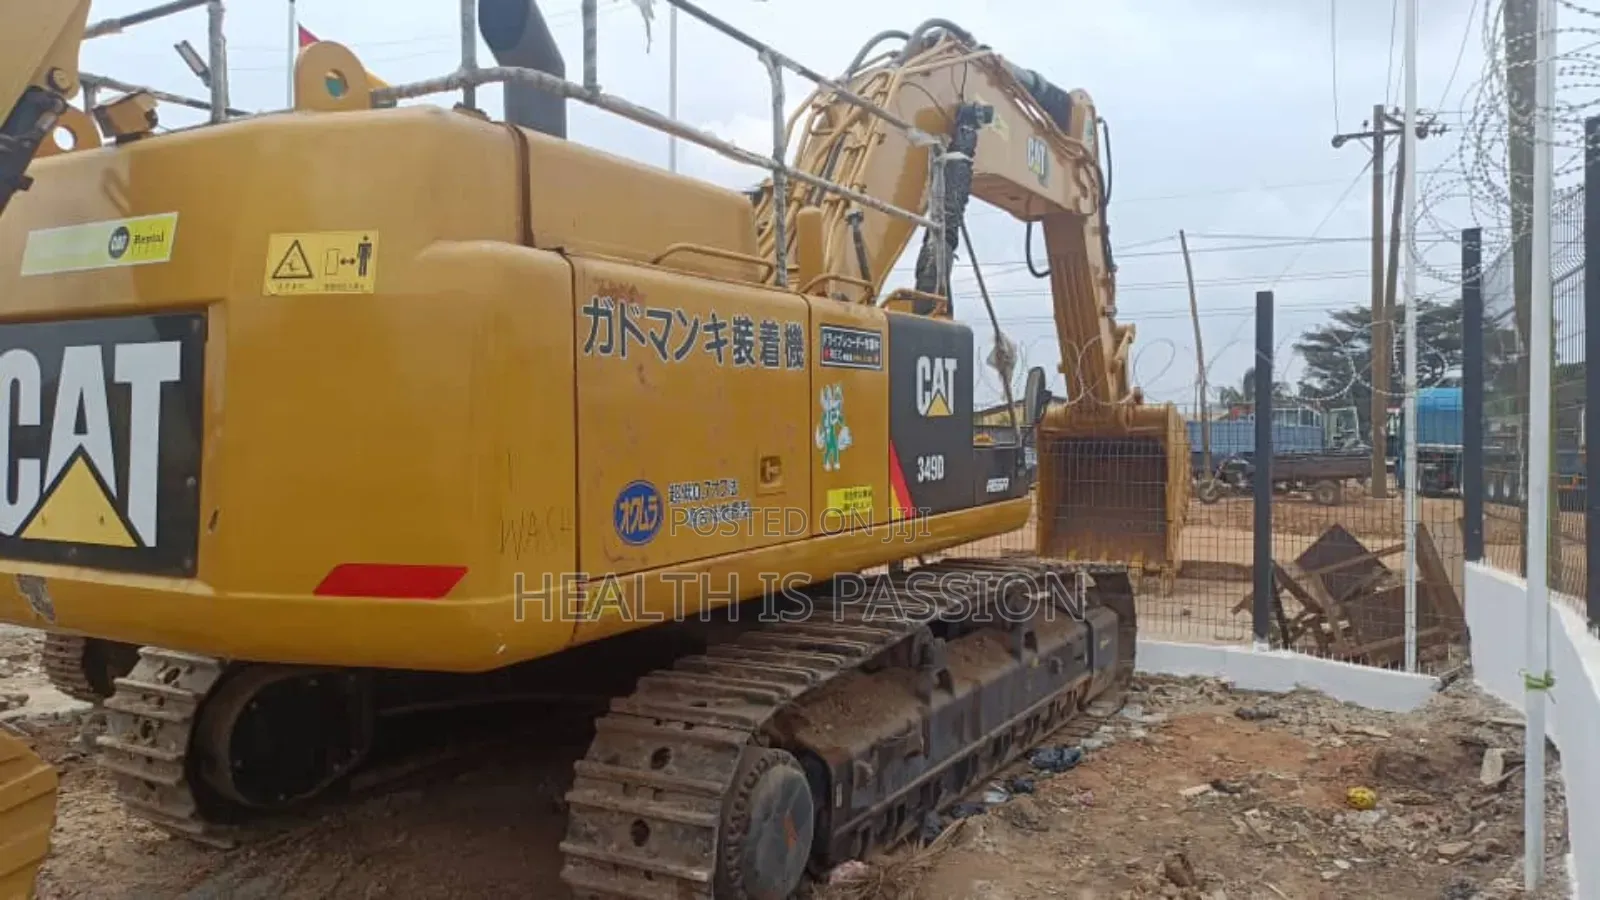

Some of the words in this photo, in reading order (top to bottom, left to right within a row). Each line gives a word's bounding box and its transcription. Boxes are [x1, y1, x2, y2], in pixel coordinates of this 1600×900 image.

[582, 296, 804, 370] ガドマンキ装着機
[917, 356, 957, 416] CAT
[0, 341, 182, 548] CAT
[917, 454, 945, 483] 349D
